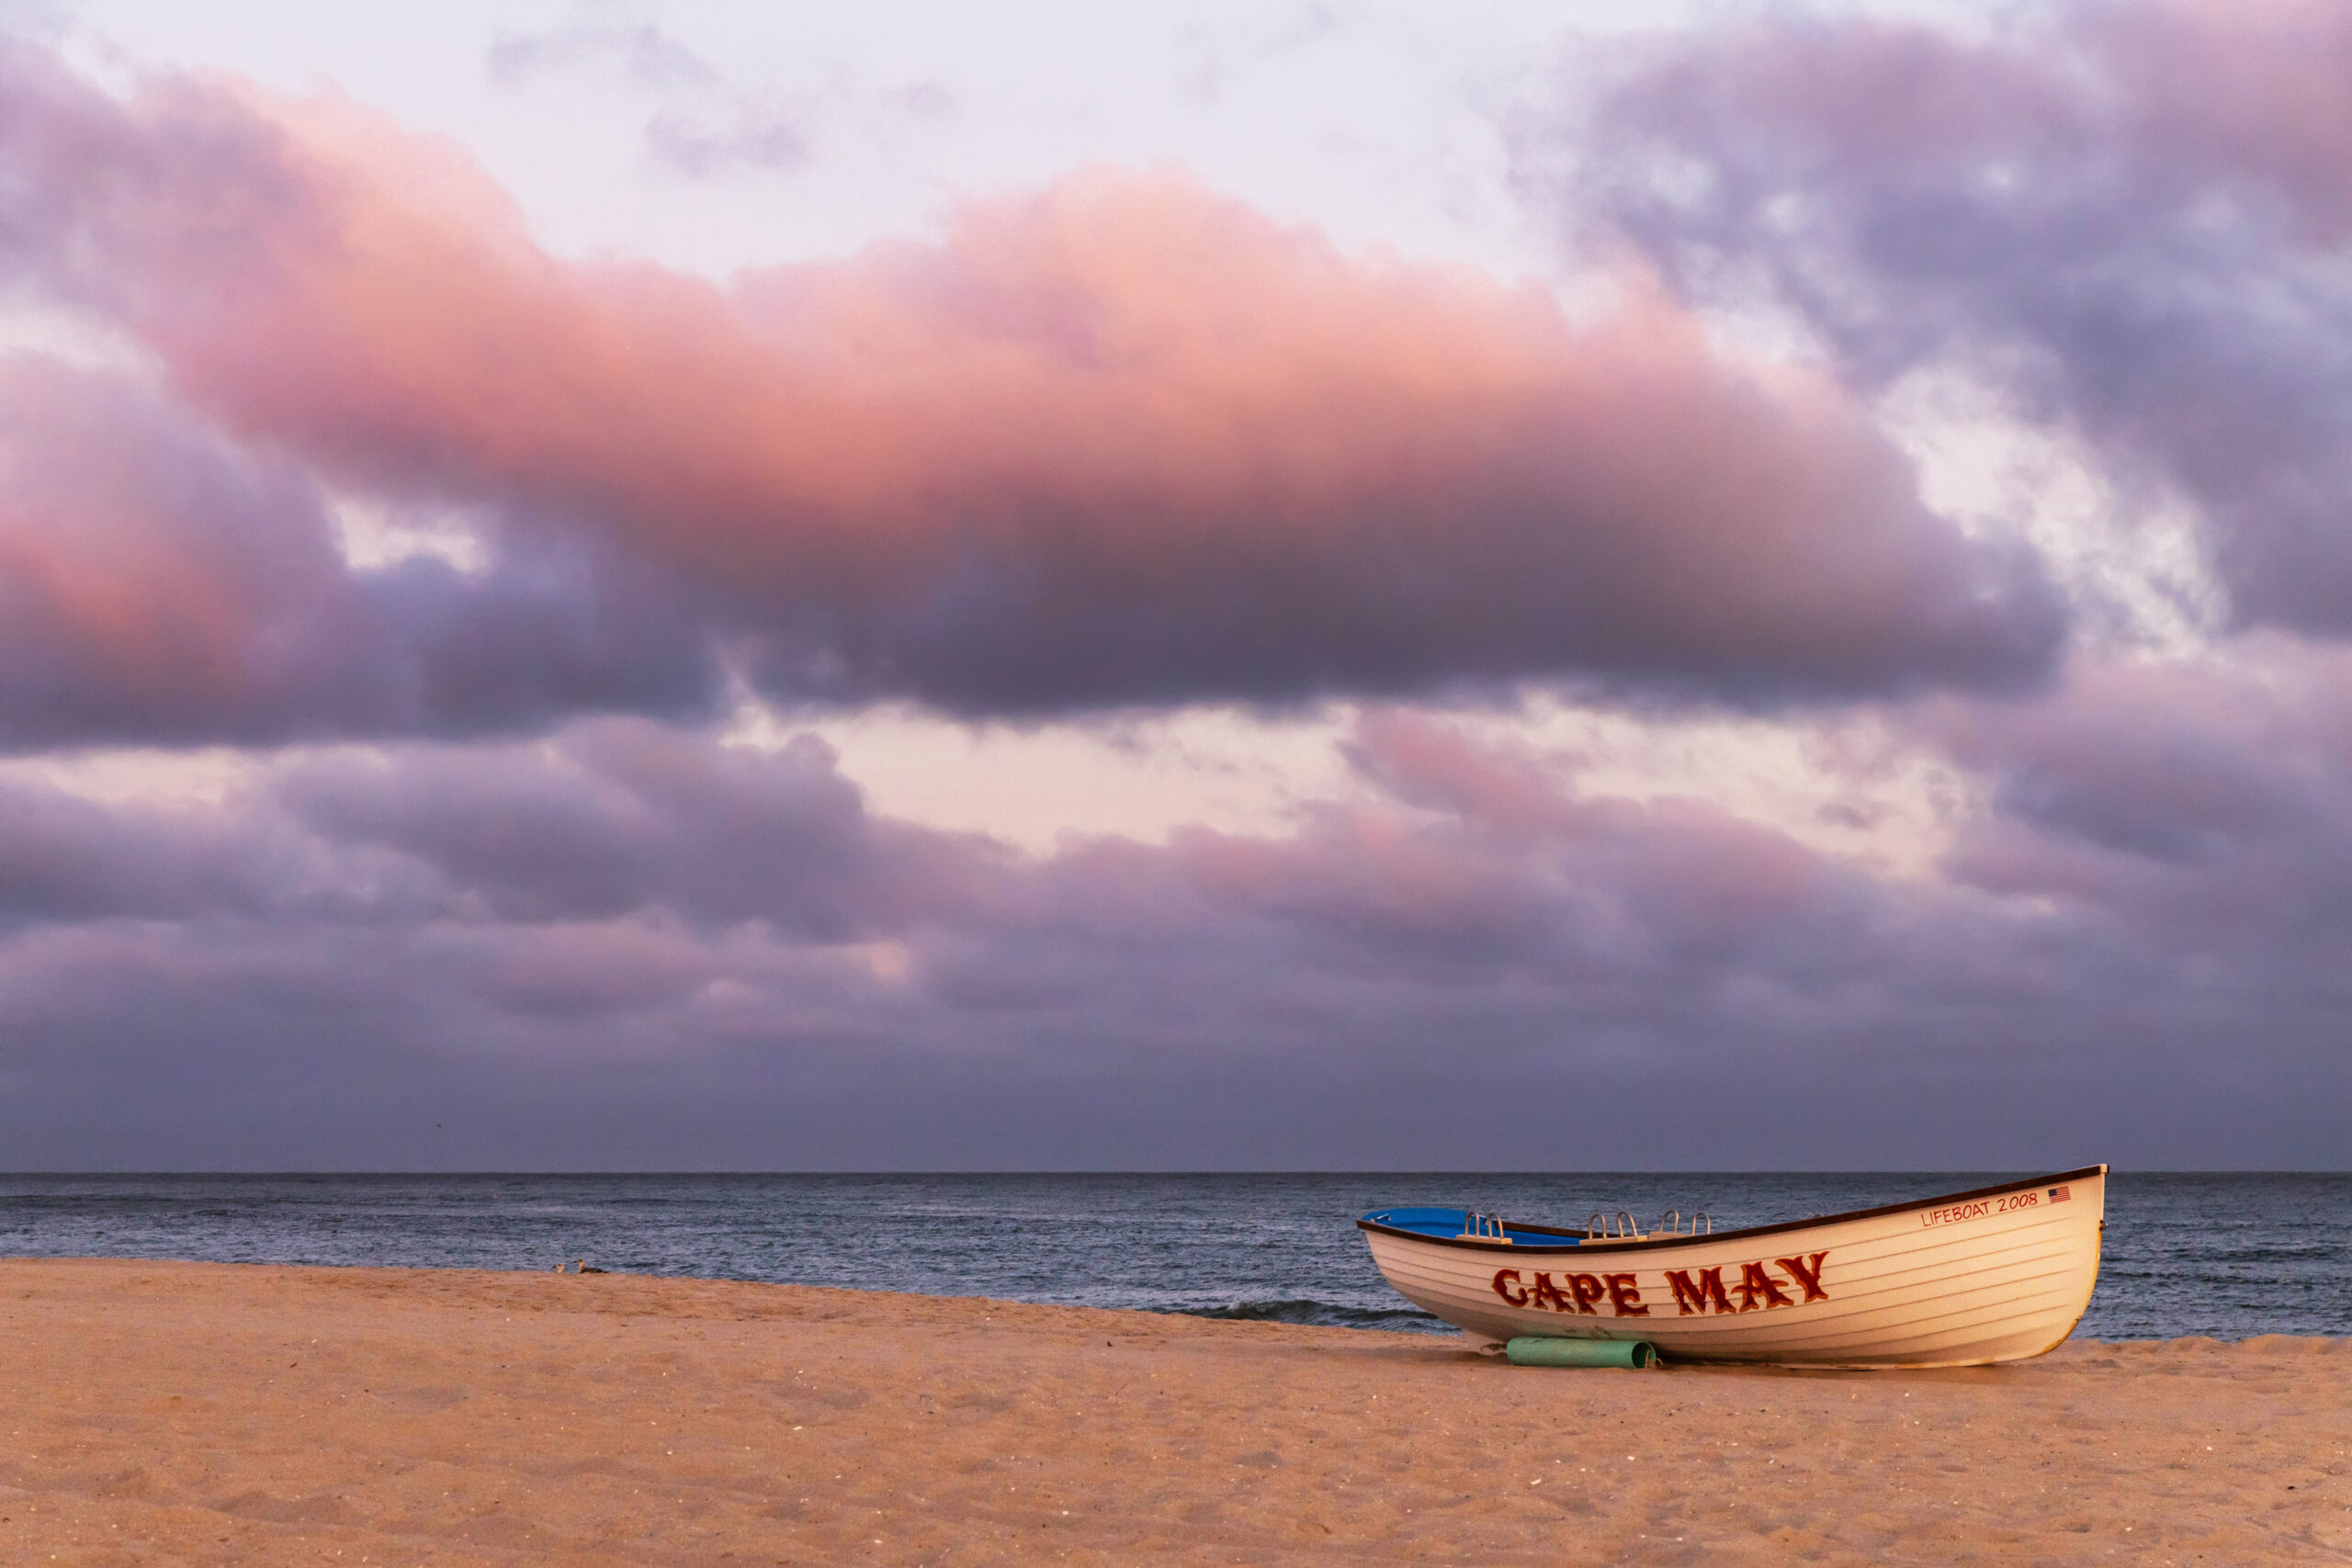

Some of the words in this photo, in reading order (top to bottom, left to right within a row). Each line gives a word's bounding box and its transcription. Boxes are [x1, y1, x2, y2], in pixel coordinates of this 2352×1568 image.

[1920, 1201, 1991, 1227] LIFEBOAT
[1998, 1192, 2038, 1213] 2008
[1492, 1269, 1651, 1318] CAPE
[1664, 1251, 1831, 1316] MAY
